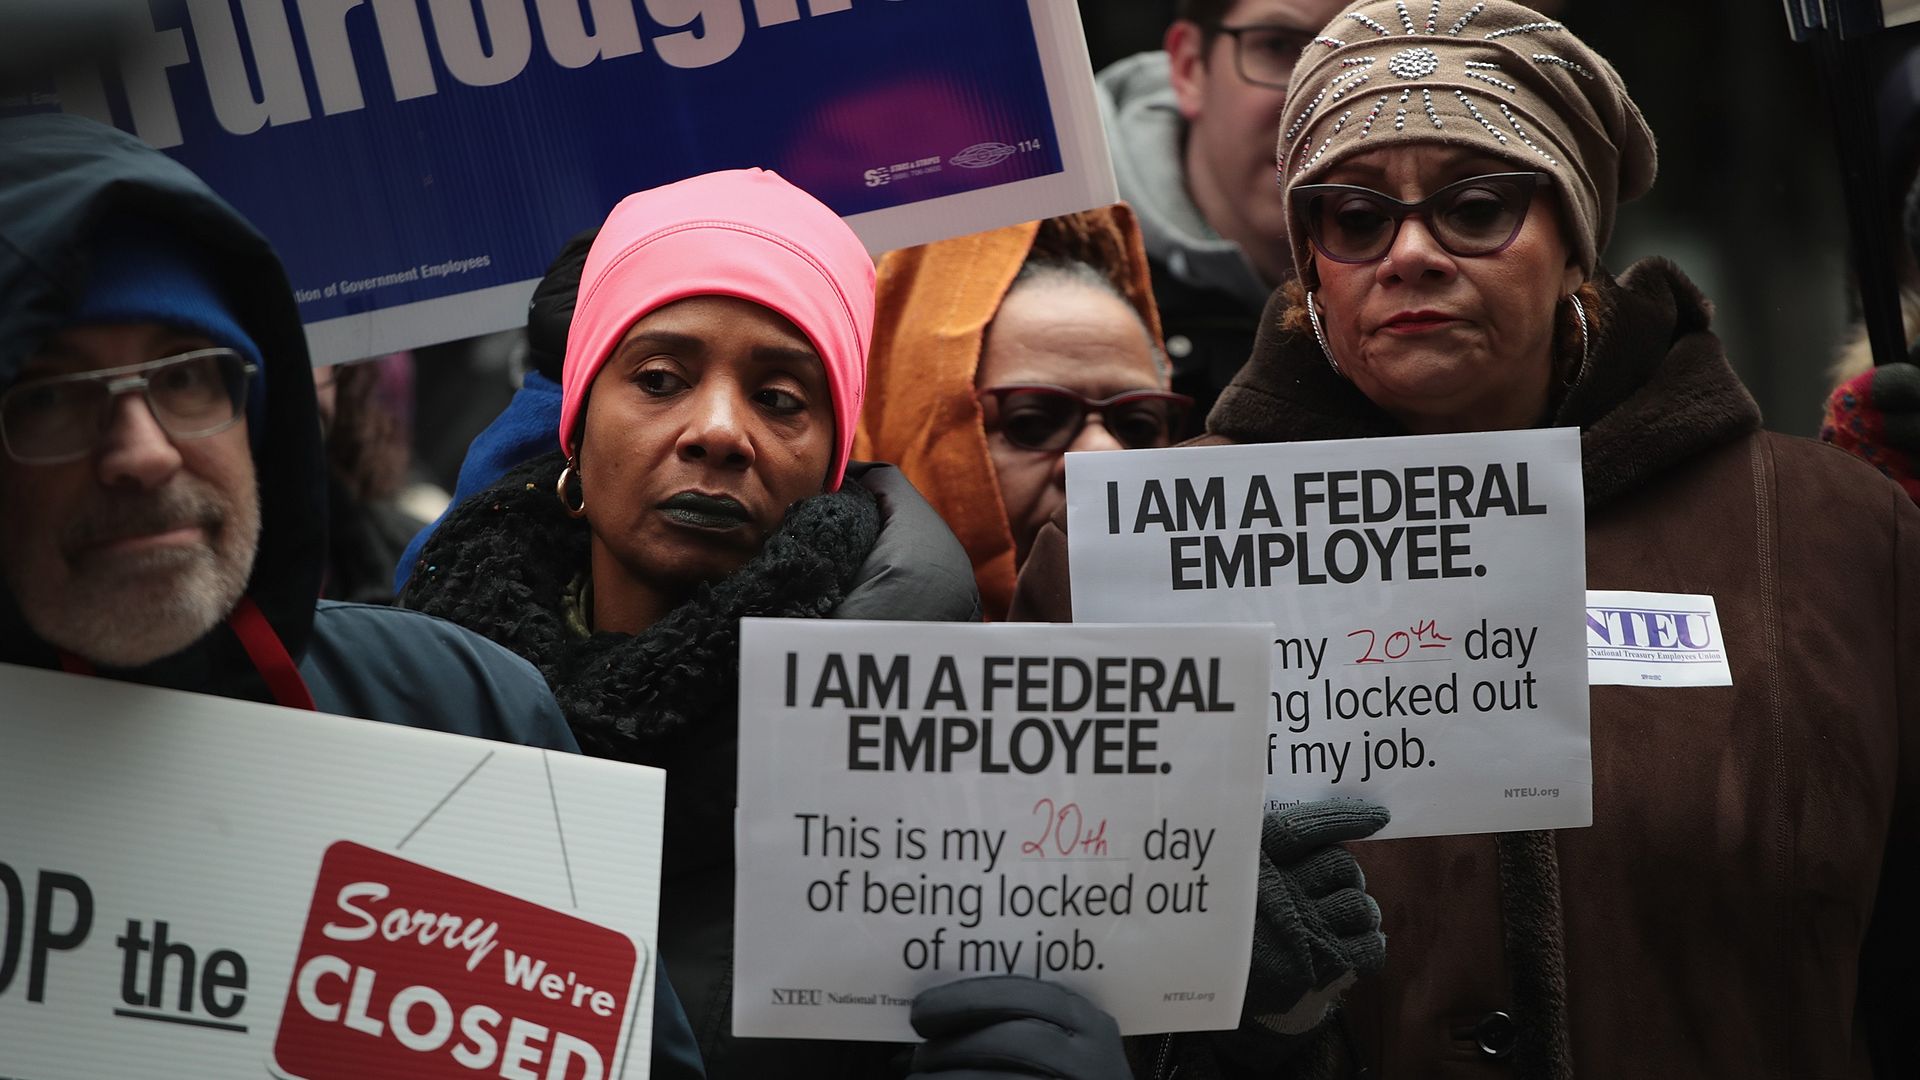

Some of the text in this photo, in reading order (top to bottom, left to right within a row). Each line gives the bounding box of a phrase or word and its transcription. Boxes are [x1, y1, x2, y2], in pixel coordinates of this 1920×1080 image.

[1018, 138, 1040, 153] 114
[324, 283, 337, 297] of
[339, 268, 419, 294] Government
[421, 254, 491, 279] Employees
[1106, 461, 1548, 535] I AM A FEDERAL
[1170, 523, 1488, 591] EMPLOYEE.
[1347, 619, 1452, 664] 20th
[1464, 618, 1538, 669] day
[1586, 610, 1711, 650] NTEU
[1591, 649, 1622, 657] National
[1624, 650, 1655, 660] Treasury
[1657, 652, 1697, 662] Employees
[785, 652, 1235, 713] I AM A FEDERAL
[1325, 675, 1458, 720] locked
[1472, 671, 1538, 712] out
[847, 716, 1172, 774] EMPLOYEE.
[1290, 741, 1351, 784] my
[1360, 727, 1436, 782] job.
[1504, 787, 1559, 799] NTEU.org
[794, 798, 1216, 872] This is my 20th day
[322, 881, 499, 972] Sorry
[807, 871, 1209, 928] of being locked out
[116, 917, 248, 1019] the
[903, 928, 1104, 976] of my job.
[503, 948, 616, 1016] We're
[771, 988, 823, 1006] NTEU
[827, 992, 877, 1005] National
[1163, 992, 1216, 1002] NTEU.org
[297, 954, 604, 1080] CLOSED
